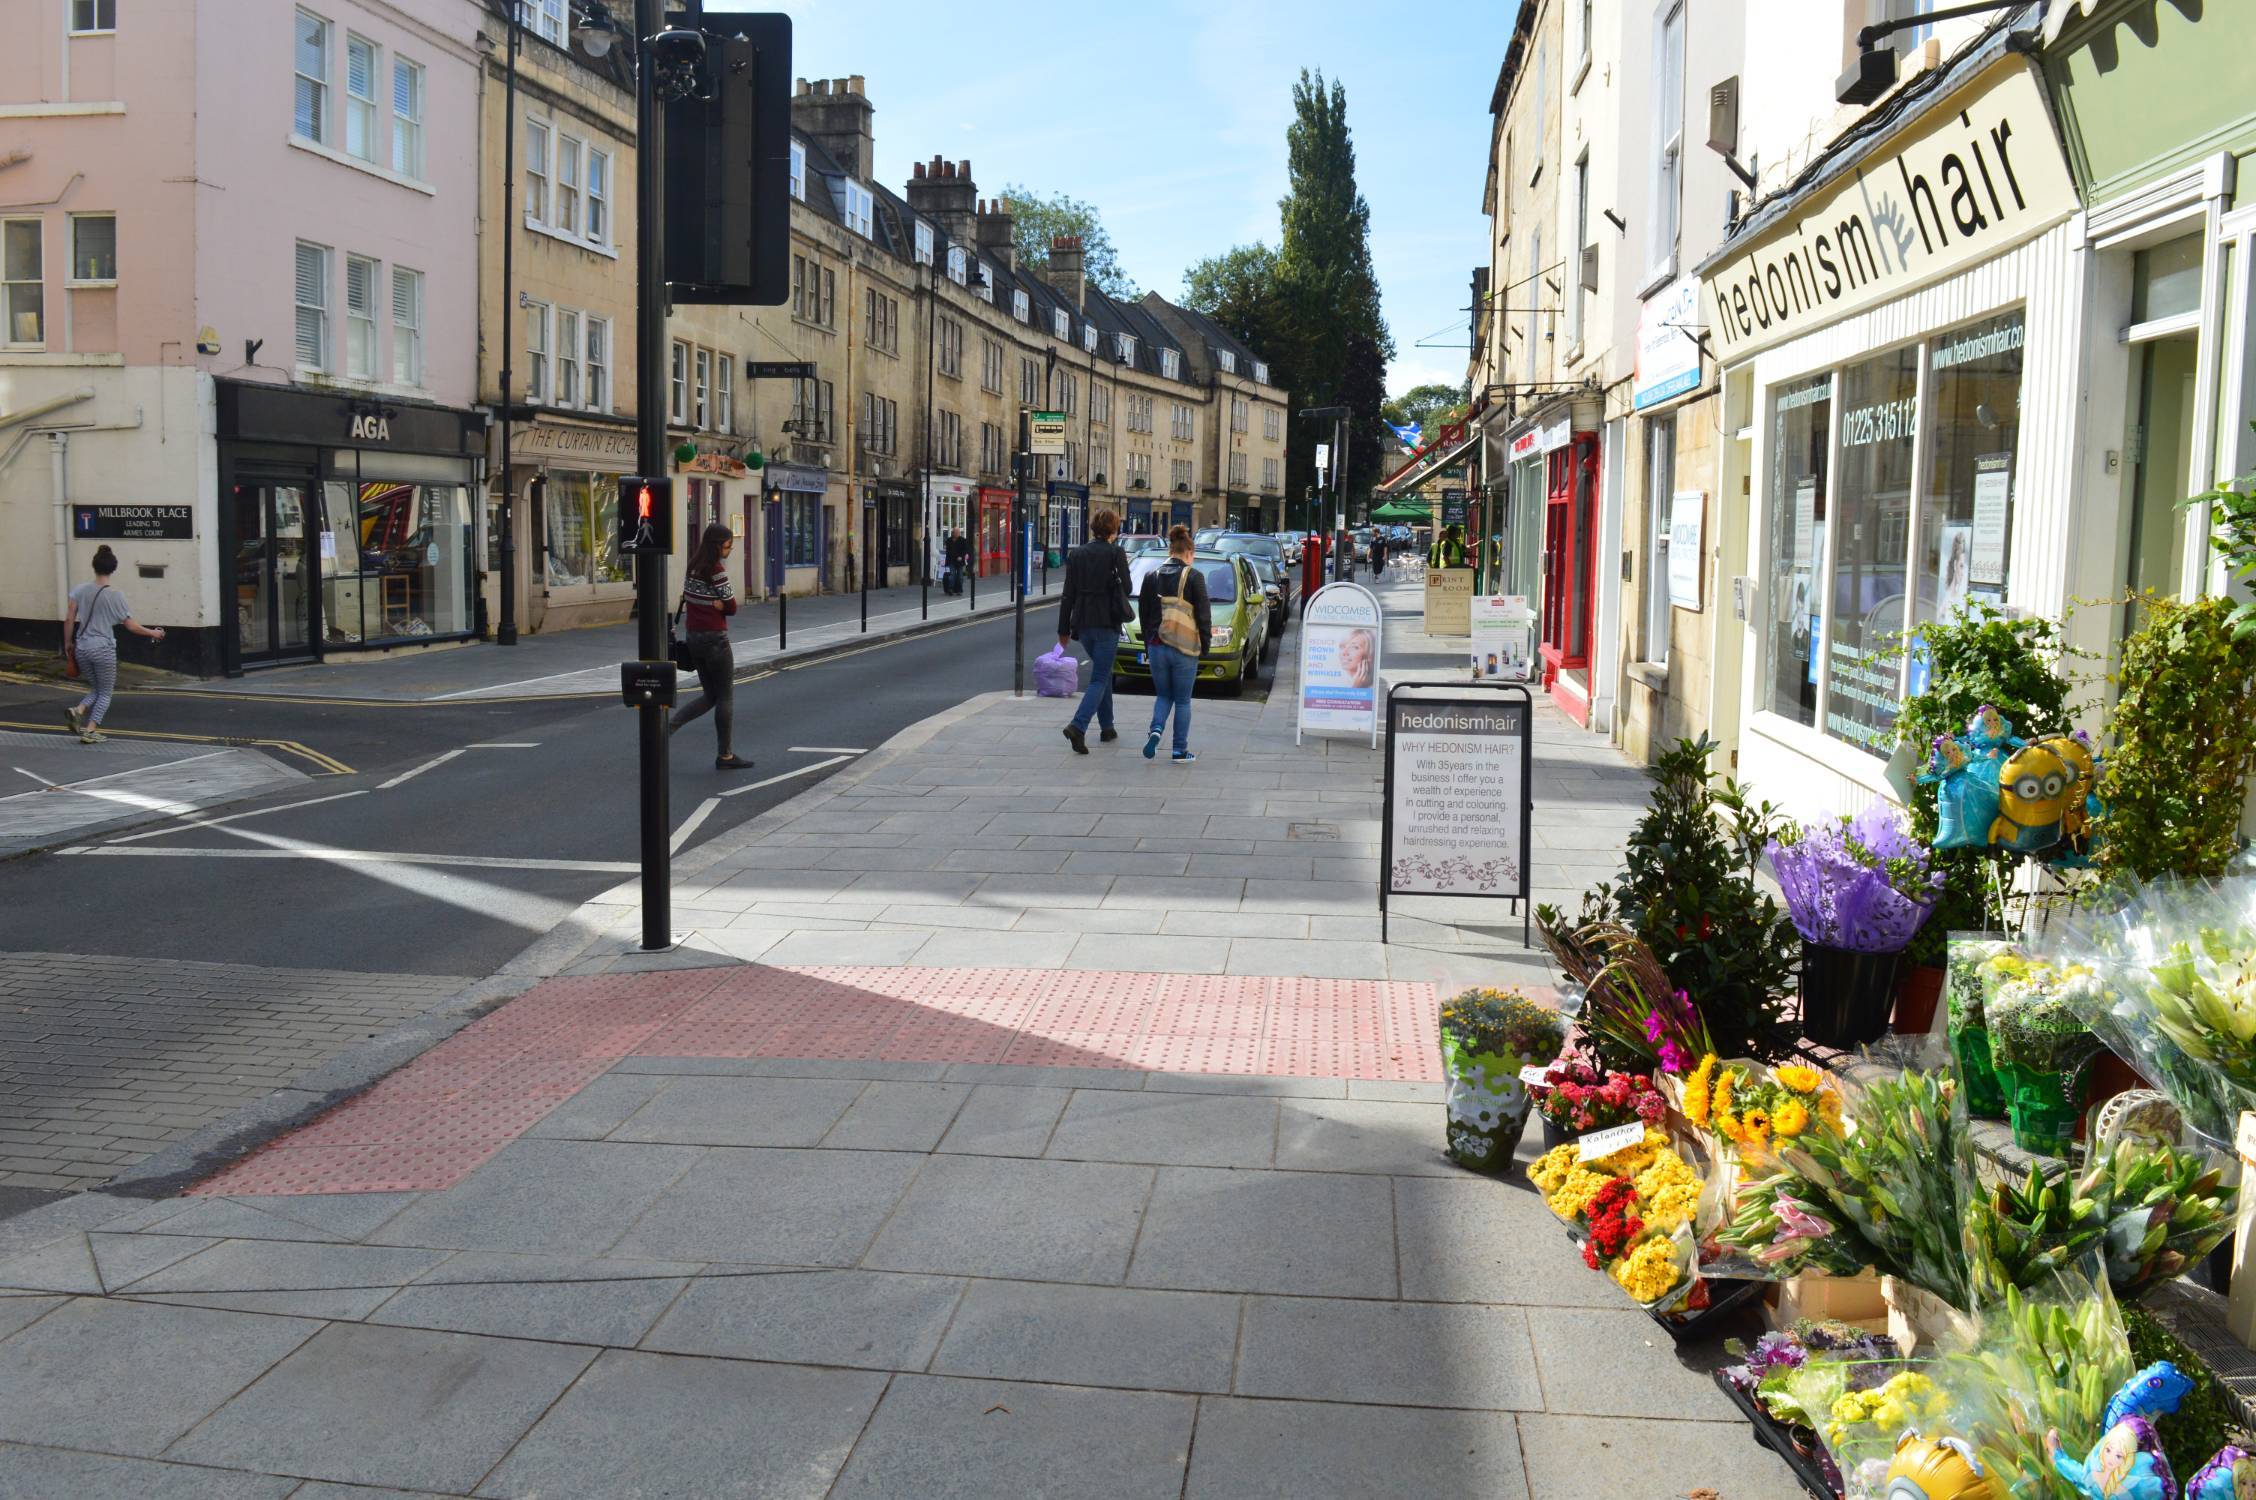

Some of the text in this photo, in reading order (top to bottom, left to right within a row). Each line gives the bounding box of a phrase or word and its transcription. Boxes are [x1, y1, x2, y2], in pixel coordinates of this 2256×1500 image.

[1713, 222, 1879, 345] hedonism
[1897, 109, 2026, 255] hair
[351, 415, 390, 441] AGA
[1843, 396, 1917, 447] 01225 315112
[530, 427, 638, 456] THE CURTAIN EXCHA
[98, 507, 188, 519] MILLBROOK PLACE
[1314, 605, 1371, 616] WIDCOMBE
[1401, 712, 1517, 731] hedonismhair
[1402, 743, 1515, 755] WHY HEDONISM HAIR?
[1416, 760, 1436, 770] With
[1475, 762, 1484, 771] in
[1486, 762, 1499, 771] the
[1411, 772, 1449, 782] business
[1457, 773, 1477, 783] offer
[1479, 777, 1496, 785] you
[1498, 776, 1504, 784] a
[1412, 785, 1502, 799] wealth of experience
[1405, 798, 1509, 813] in cutting and colouring.
[1418, 812, 1450, 824] provide
[1452, 814, 1458, 822] a
[1460, 814, 1501, 825] personal,
[1408, 824, 1505, 838] unrushed and relaxing
[1403, 836, 1510, 850] hairdressing experience.
